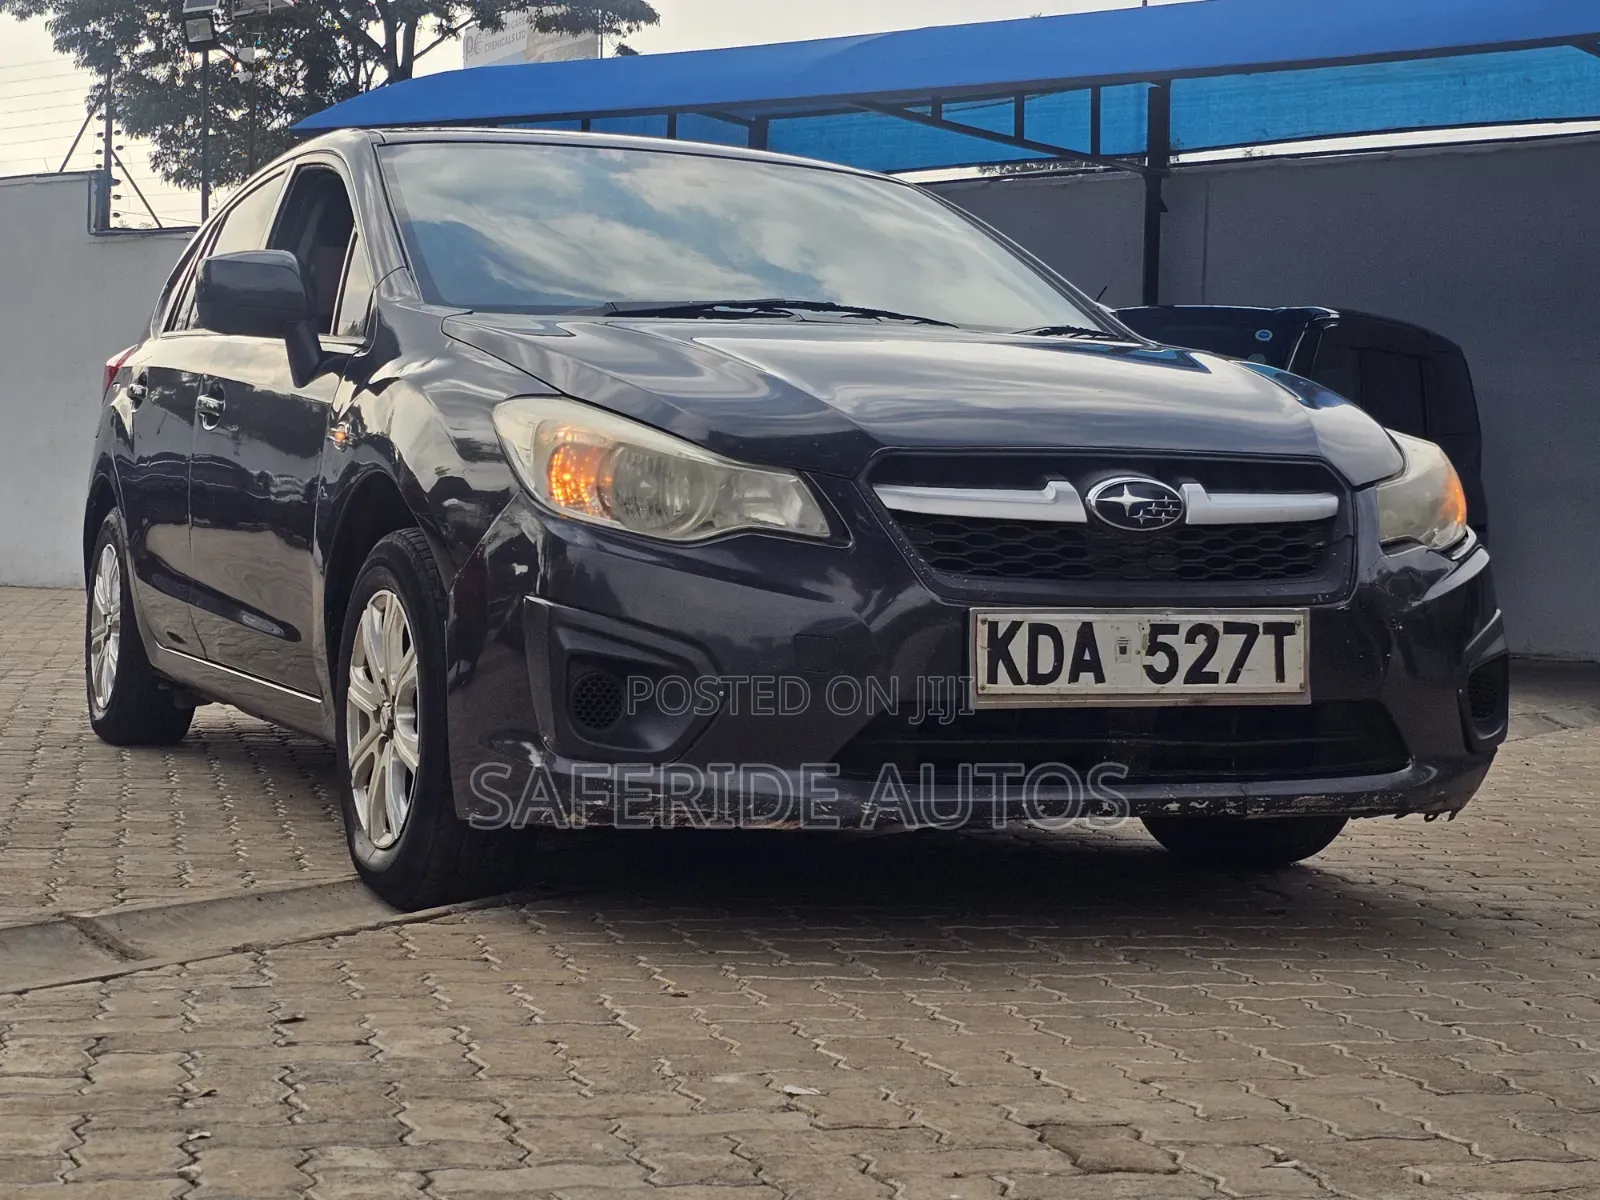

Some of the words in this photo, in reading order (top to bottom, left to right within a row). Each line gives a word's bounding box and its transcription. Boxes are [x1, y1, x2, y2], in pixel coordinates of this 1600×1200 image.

[484, 33, 515, 53] CHEMICALS
[516, 29, 527, 42] LTD
[987, 620, 1106, 686] KDA
[1142, 620, 1296, 685] 527T
